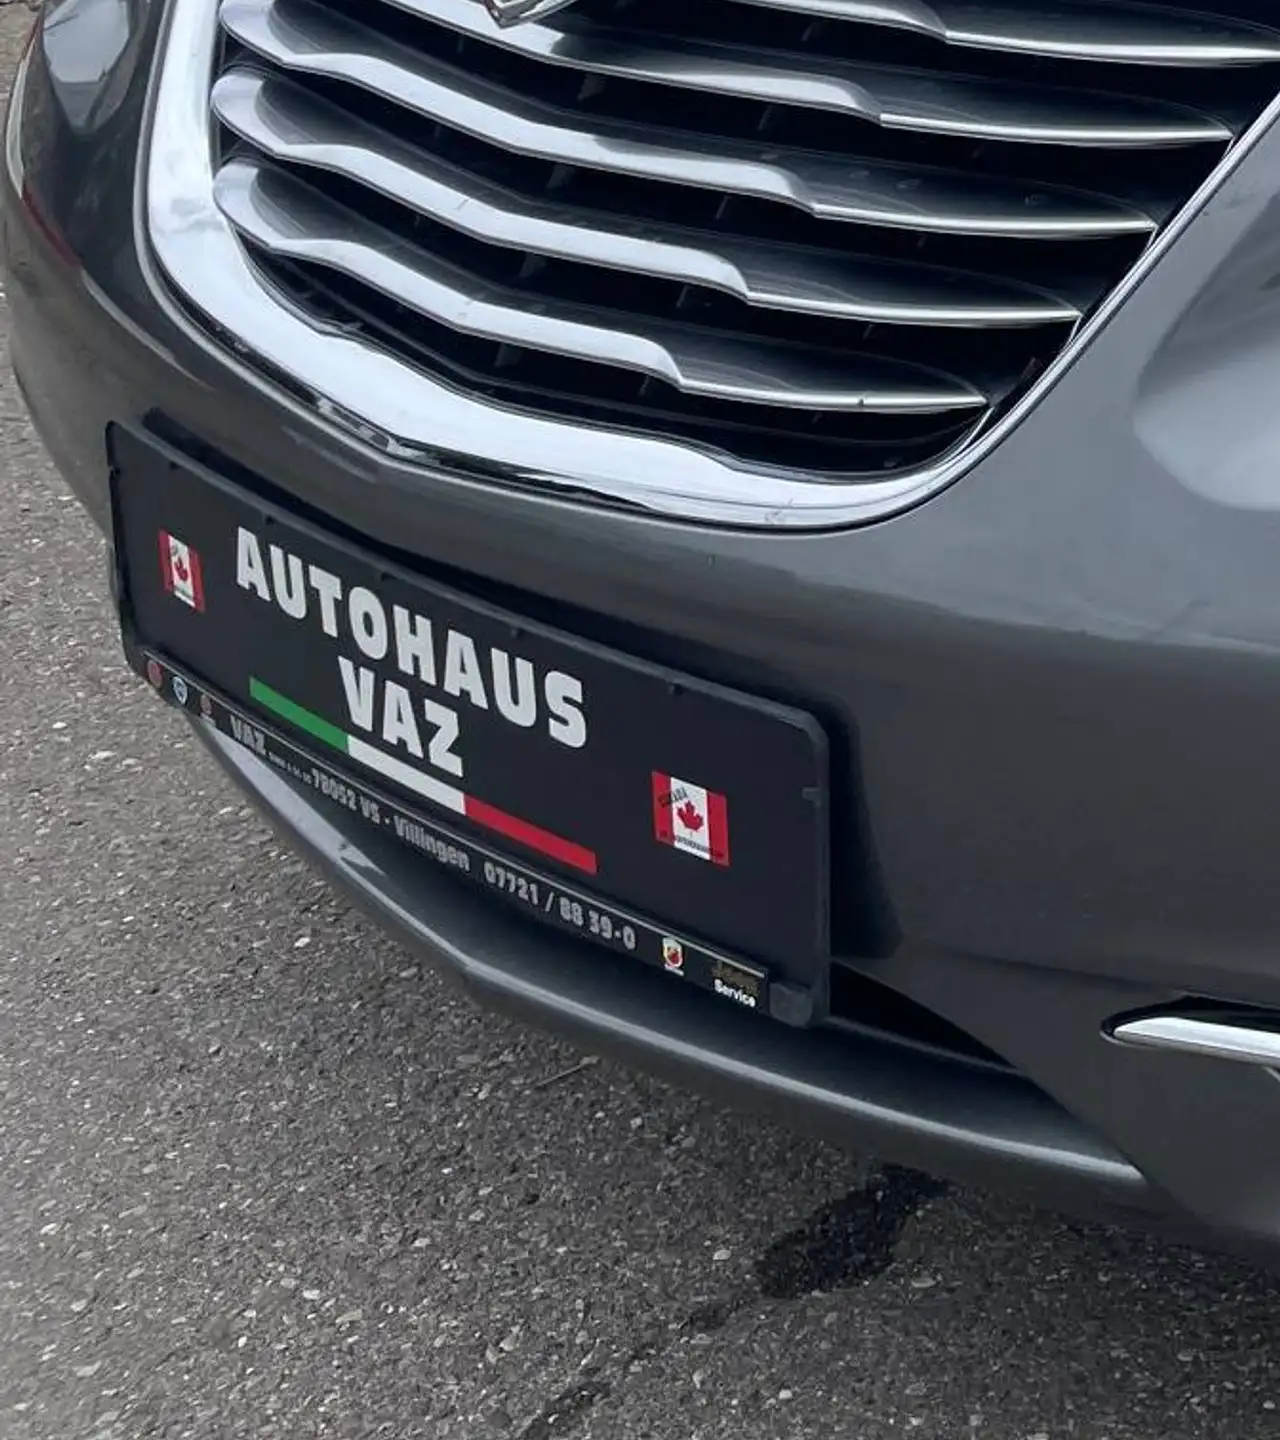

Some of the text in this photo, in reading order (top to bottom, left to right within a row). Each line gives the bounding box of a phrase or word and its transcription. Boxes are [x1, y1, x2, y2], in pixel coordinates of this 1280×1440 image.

[236, 526, 587, 748] AUTOHAUS
[338, 655, 464, 777] VAZ
[230, 714, 266, 756] VAZ
[360, 796, 381, 826] VS
[393, 814, 470, 873] Villingen
[484, 861, 539, 906] 07721
[544, 892, 554, 912] /
[588, 910, 636, 951] 39-0
[714, 978, 756, 1008] Service
